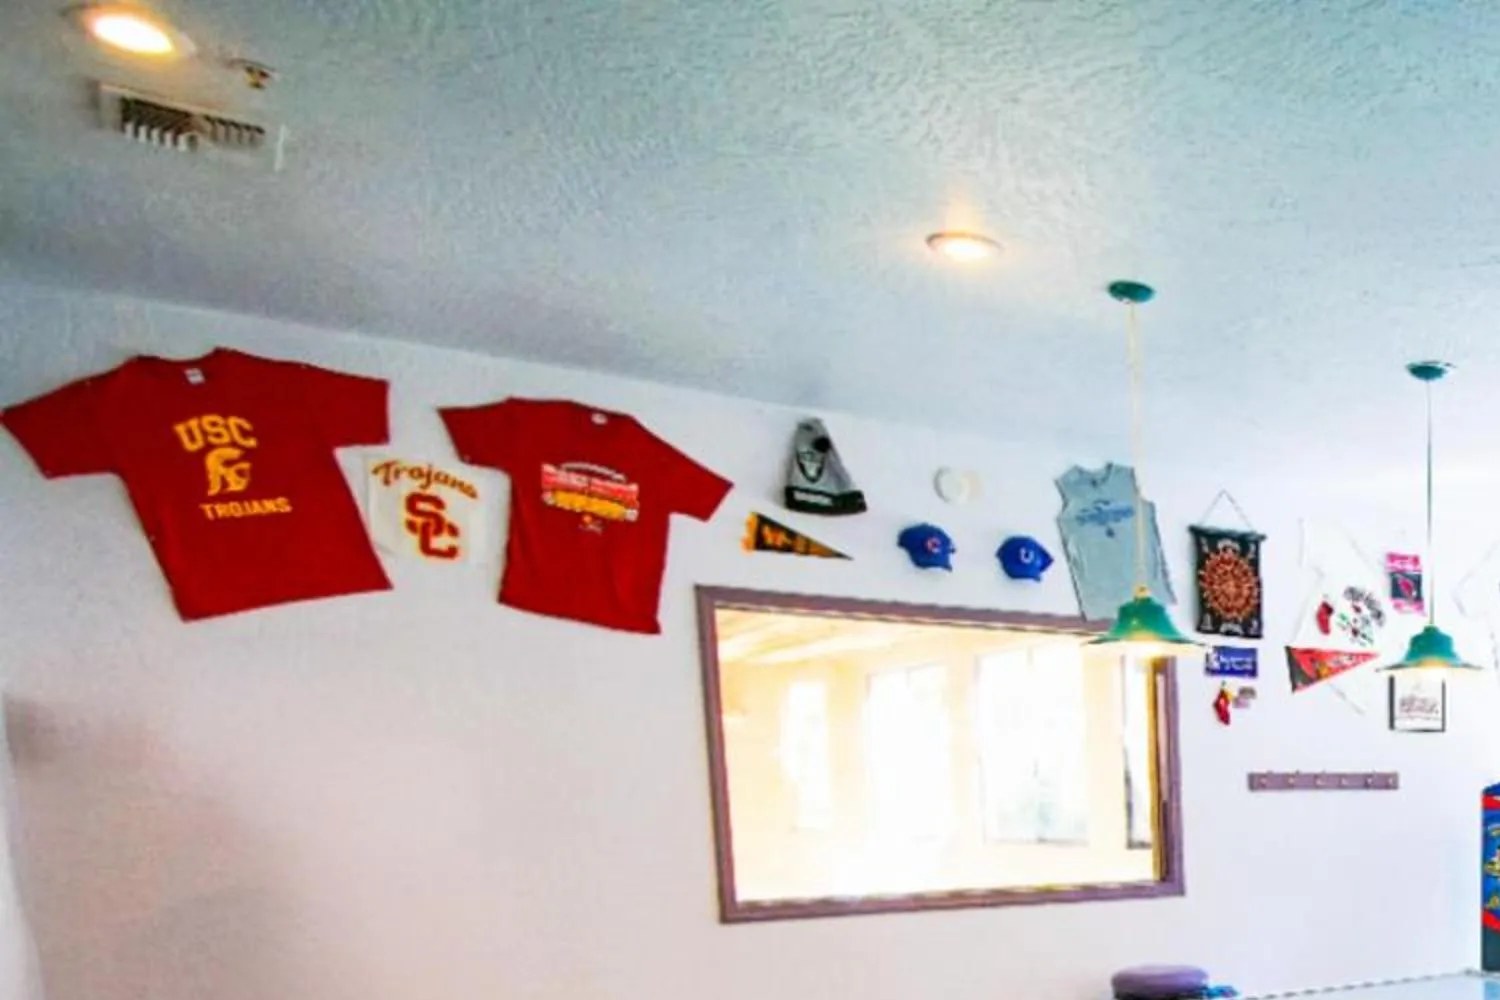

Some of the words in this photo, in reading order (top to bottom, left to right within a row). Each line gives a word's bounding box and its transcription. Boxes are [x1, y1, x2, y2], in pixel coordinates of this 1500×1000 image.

[173, 414, 257, 452] USC
[371, 460, 478, 500] Trojans
[199, 496, 293, 520] TROJANS
